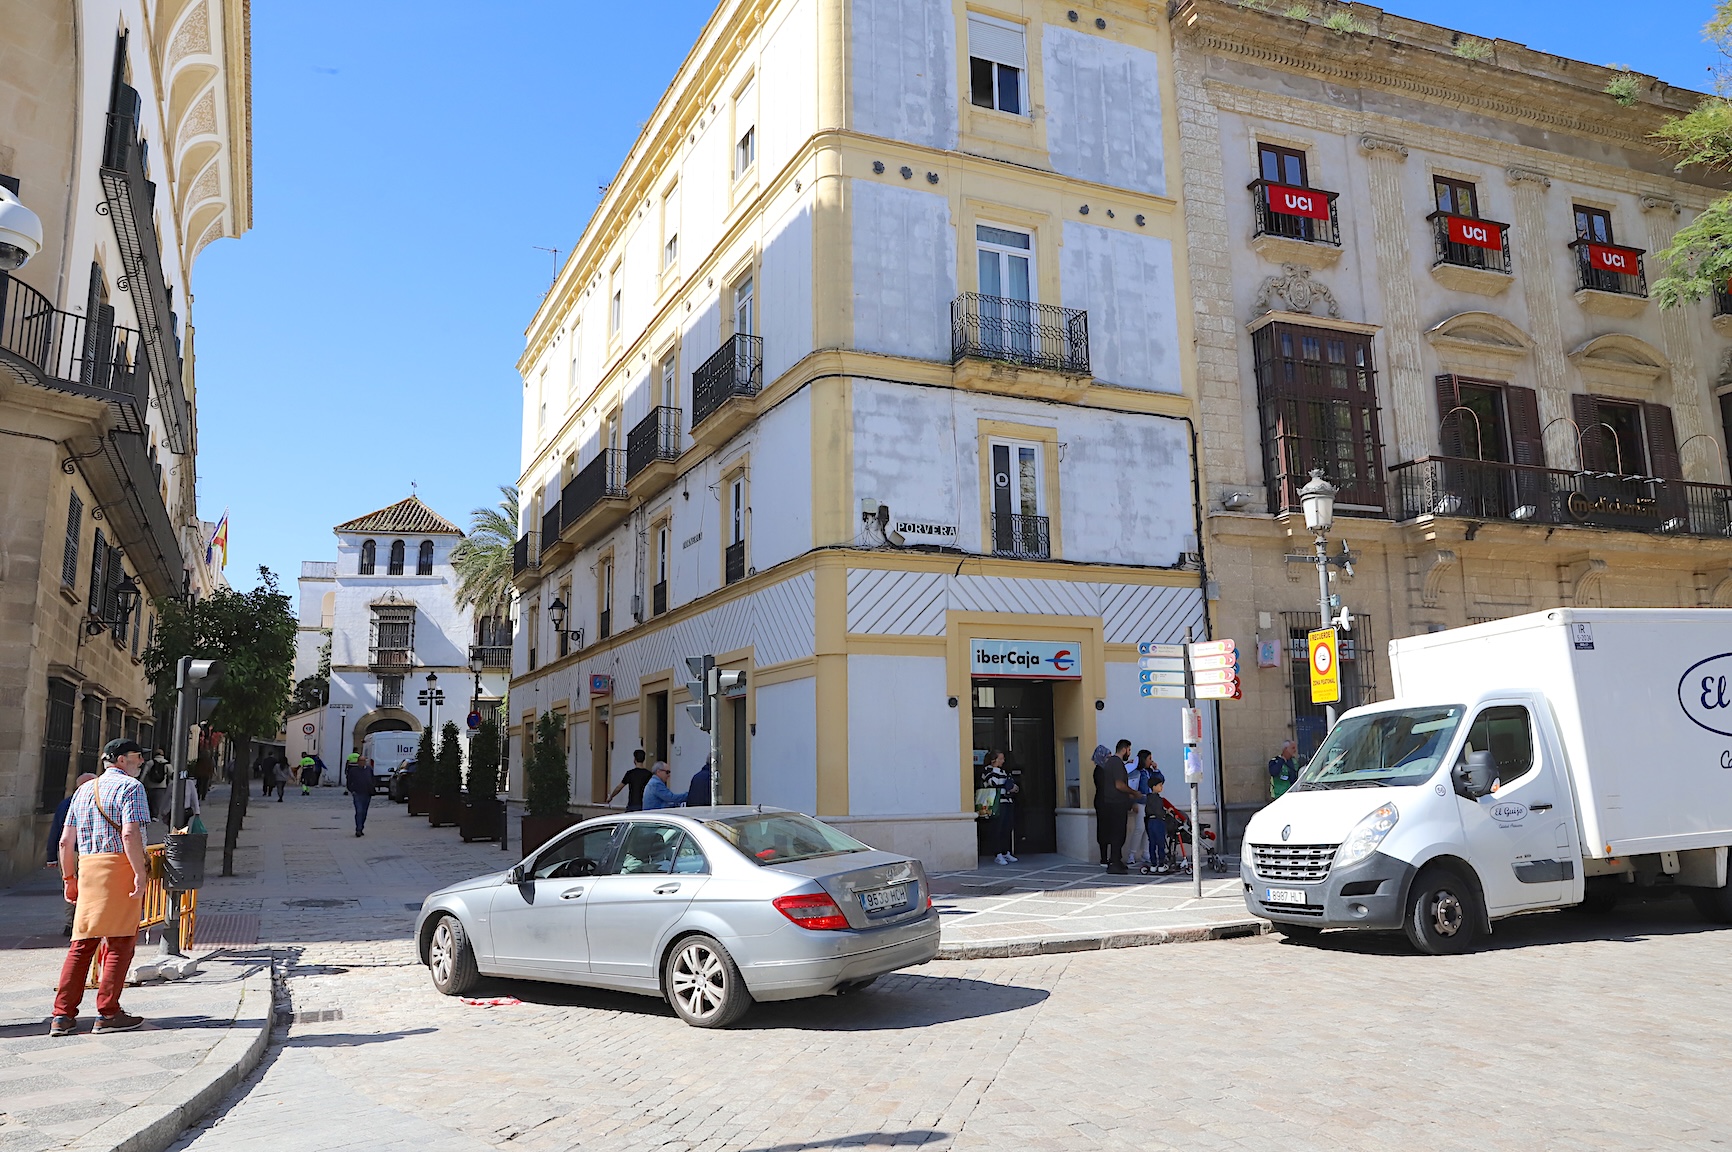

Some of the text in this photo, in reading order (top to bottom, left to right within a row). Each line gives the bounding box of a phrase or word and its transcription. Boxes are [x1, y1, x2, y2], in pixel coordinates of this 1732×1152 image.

[1284, 194, 1313, 212] UCI
[1462, 225, 1487, 242] UCI
[1602, 252, 1625, 268] UCI
[896, 522, 957, 536] PORVERA
[976, 649, 1040, 669] iberCaja
[1700, 675, 1731, 710] El
[397, 744, 414, 754] llar
[867, 886, 906, 907] 9533 HCH
[1272, 890, 1303, 902] 8987 HLT
